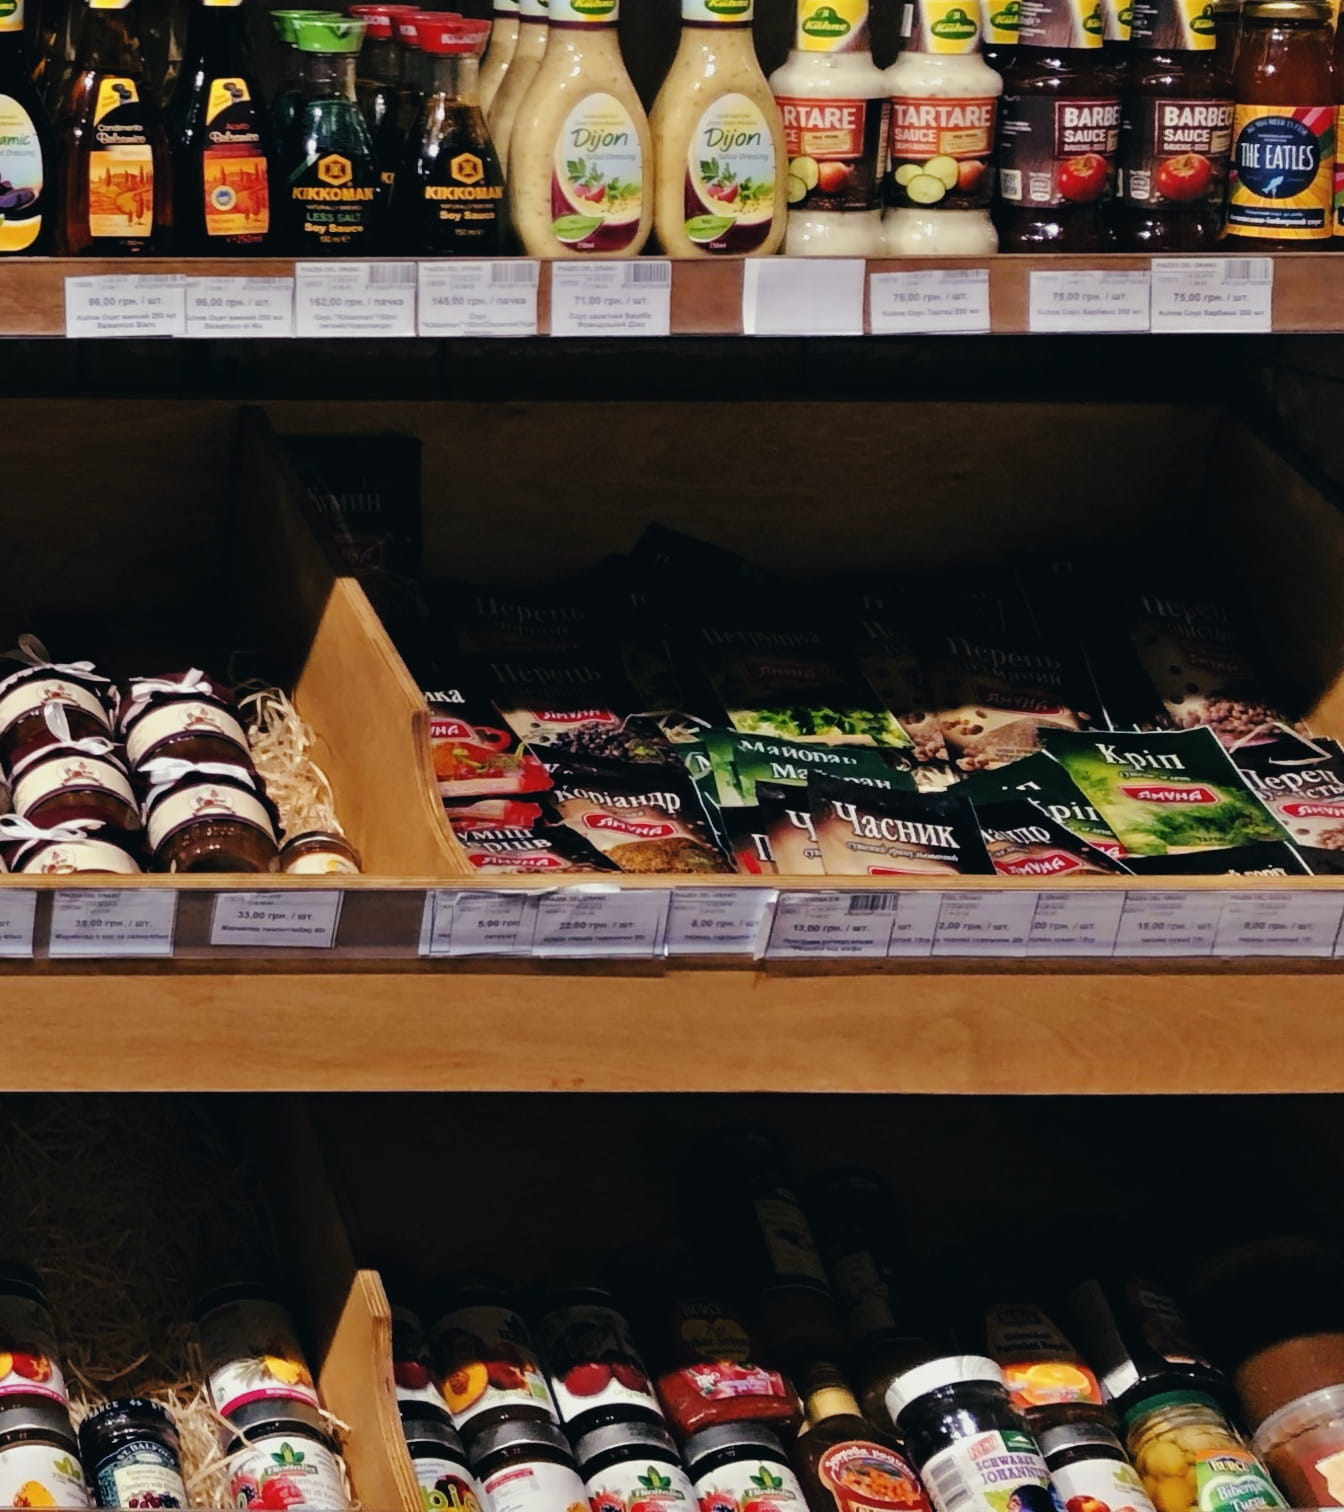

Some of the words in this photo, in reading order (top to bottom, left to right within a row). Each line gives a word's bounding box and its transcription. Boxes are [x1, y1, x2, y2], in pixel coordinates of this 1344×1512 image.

[896, 105, 991, 128] TARTARE
[572, 128, 628, 151] Dijon
[706, 128, 760, 151] Dijon
[896, 129, 936, 143] SAUCE
[1065, 129, 1106, 143] SAUCE
[1165, 128, 1210, 142] SAUCE
[1240, 142, 1261, 168] THE
[1265, 141, 1314, 170] EATLES
[292, 186, 374, 201] KIKKOMAN
[425, 185, 503, 201] KIKKOMAN
[304, 223, 327, 236] Soy
[1096, 744, 1185, 771] Кріп
[555, 784, 681, 813] Коріандр
[834, 802, 959, 849] Часник
